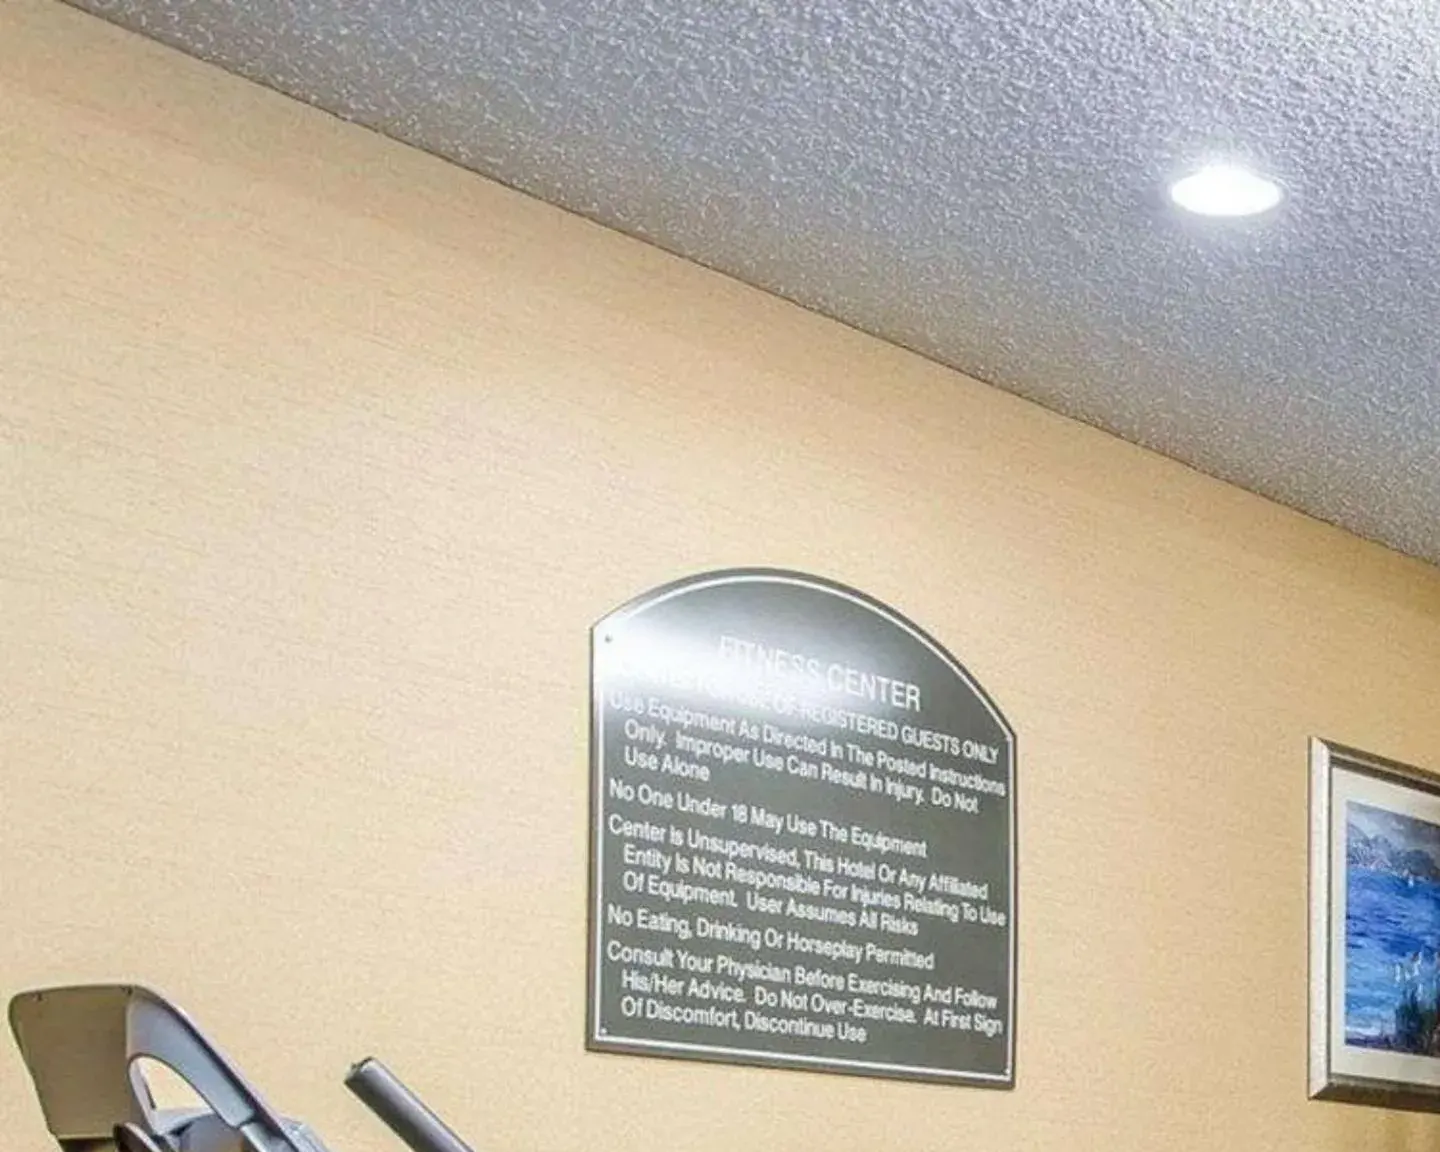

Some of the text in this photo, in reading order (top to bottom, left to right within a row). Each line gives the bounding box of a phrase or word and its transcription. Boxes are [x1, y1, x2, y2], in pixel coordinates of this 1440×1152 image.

[720, 636, 820, 681] FITNESS
[827, 662, 921, 712] CENTER
[609, 690, 1006, 795] Use Equipment As Directed In The Posted Instructions
[624, 746, 710, 781] Use Alone
[675, 729, 750, 764] Improper
[752, 745, 783, 771] Use
[786, 753, 818, 778] Can
[821, 760, 867, 789] Result
[869, 770, 883, 792] In
[931, 783, 951, 807] Do
[901, 724, 959, 755] GUESTS
[961, 738, 999, 765] ONLY
[609, 777, 927, 858] No One Under 18 May Use The Equipment
[608, 814, 666, 842] Center
[669, 825, 683, 845] Is
[803, 848, 834, 871] This
[837, 854, 875, 879] Hotel
[878, 861, 896, 882] Or
[899, 865, 927, 892] Any
[929, 870, 988, 898] Affiliated
[623, 843, 671, 875] Entity
[675, 852, 689, 873] Is
[725, 860, 820, 895] Responsible
[823, 876, 848, 899] For
[850, 881, 901, 908] Injuries
[904, 890, 959, 922] Relating
[962, 899, 978, 921] To
[979, 902, 1006, 926] Use
[607, 903, 633, 925] No
[696, 916, 761, 948] Drinking
[764, 926, 784, 947] Or
[787, 929, 863, 962] Horseplay
[865, 940, 934, 968] Permitted
[622, 871, 646, 893] Of
[746, 890, 784, 915] User
[786, 896, 856, 926] Assumes
[859, 907, 877, 929] All
[880, 910, 918, 935] Risks
[606, 939, 997, 1008] Consult Your Physician Before Exercising And Follow
[621, 968, 684, 994] His/Her
[754, 985, 778, 1006] Do
[923, 1006, 940, 1026] At
[942, 1008, 970, 1030] First
[973, 1012, 1003, 1038] Sign
[620, 996, 643, 1017] Of
[743, 1010, 834, 1038] Discontinue
[836, 1020, 866, 1042] Use
